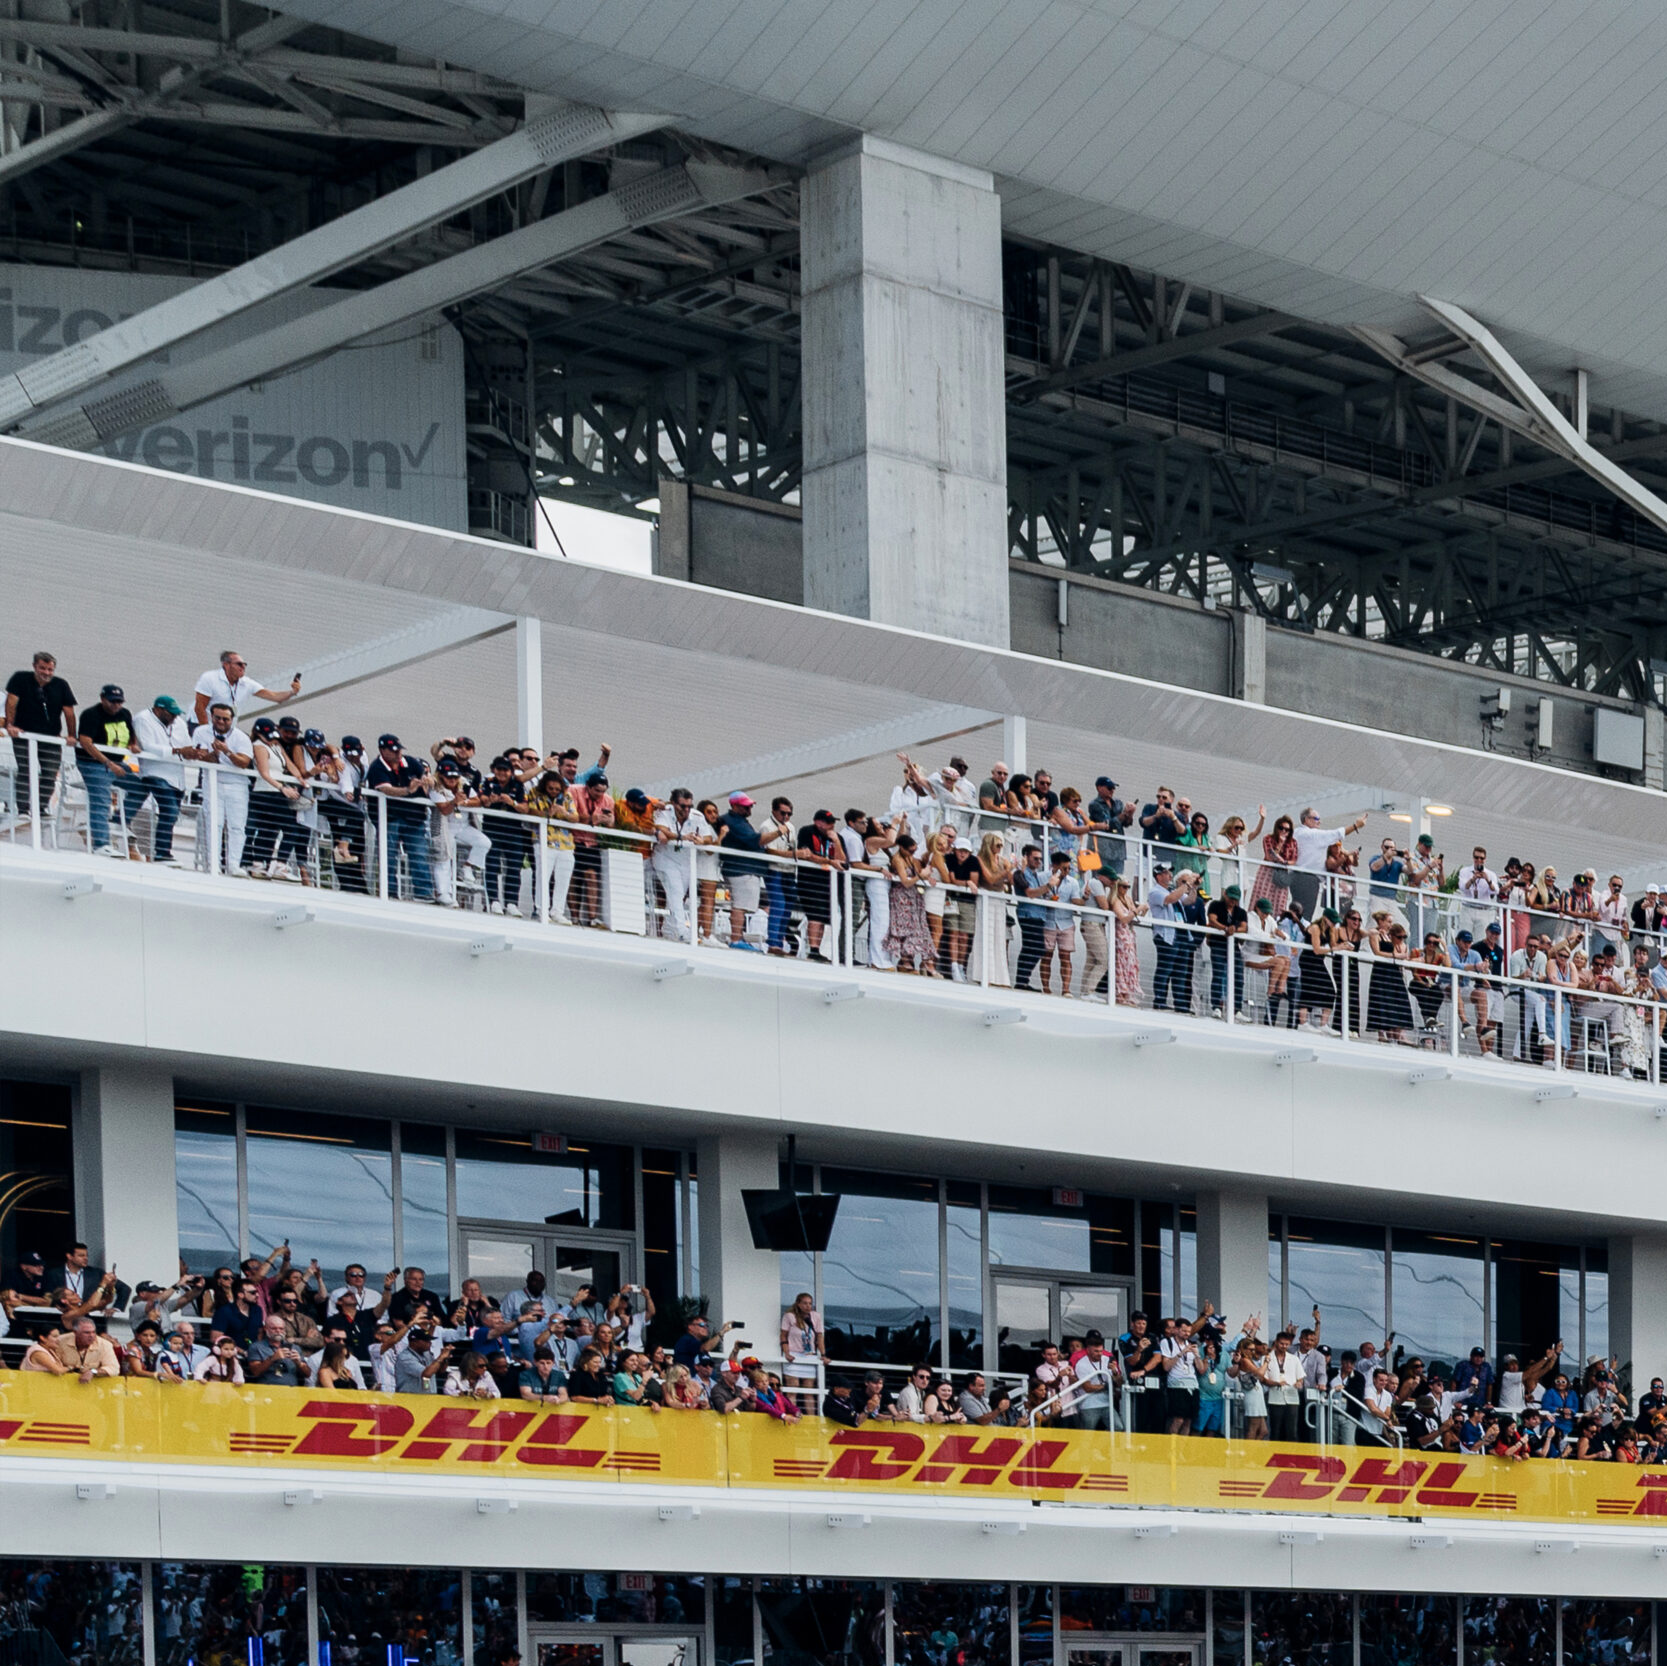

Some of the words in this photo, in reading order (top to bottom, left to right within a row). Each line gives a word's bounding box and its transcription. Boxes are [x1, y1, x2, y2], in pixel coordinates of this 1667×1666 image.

[293, 1400, 606, 1467] DHL
[827, 1430, 1082, 1488] DHL
[1264, 1454, 1478, 1507] DHL
